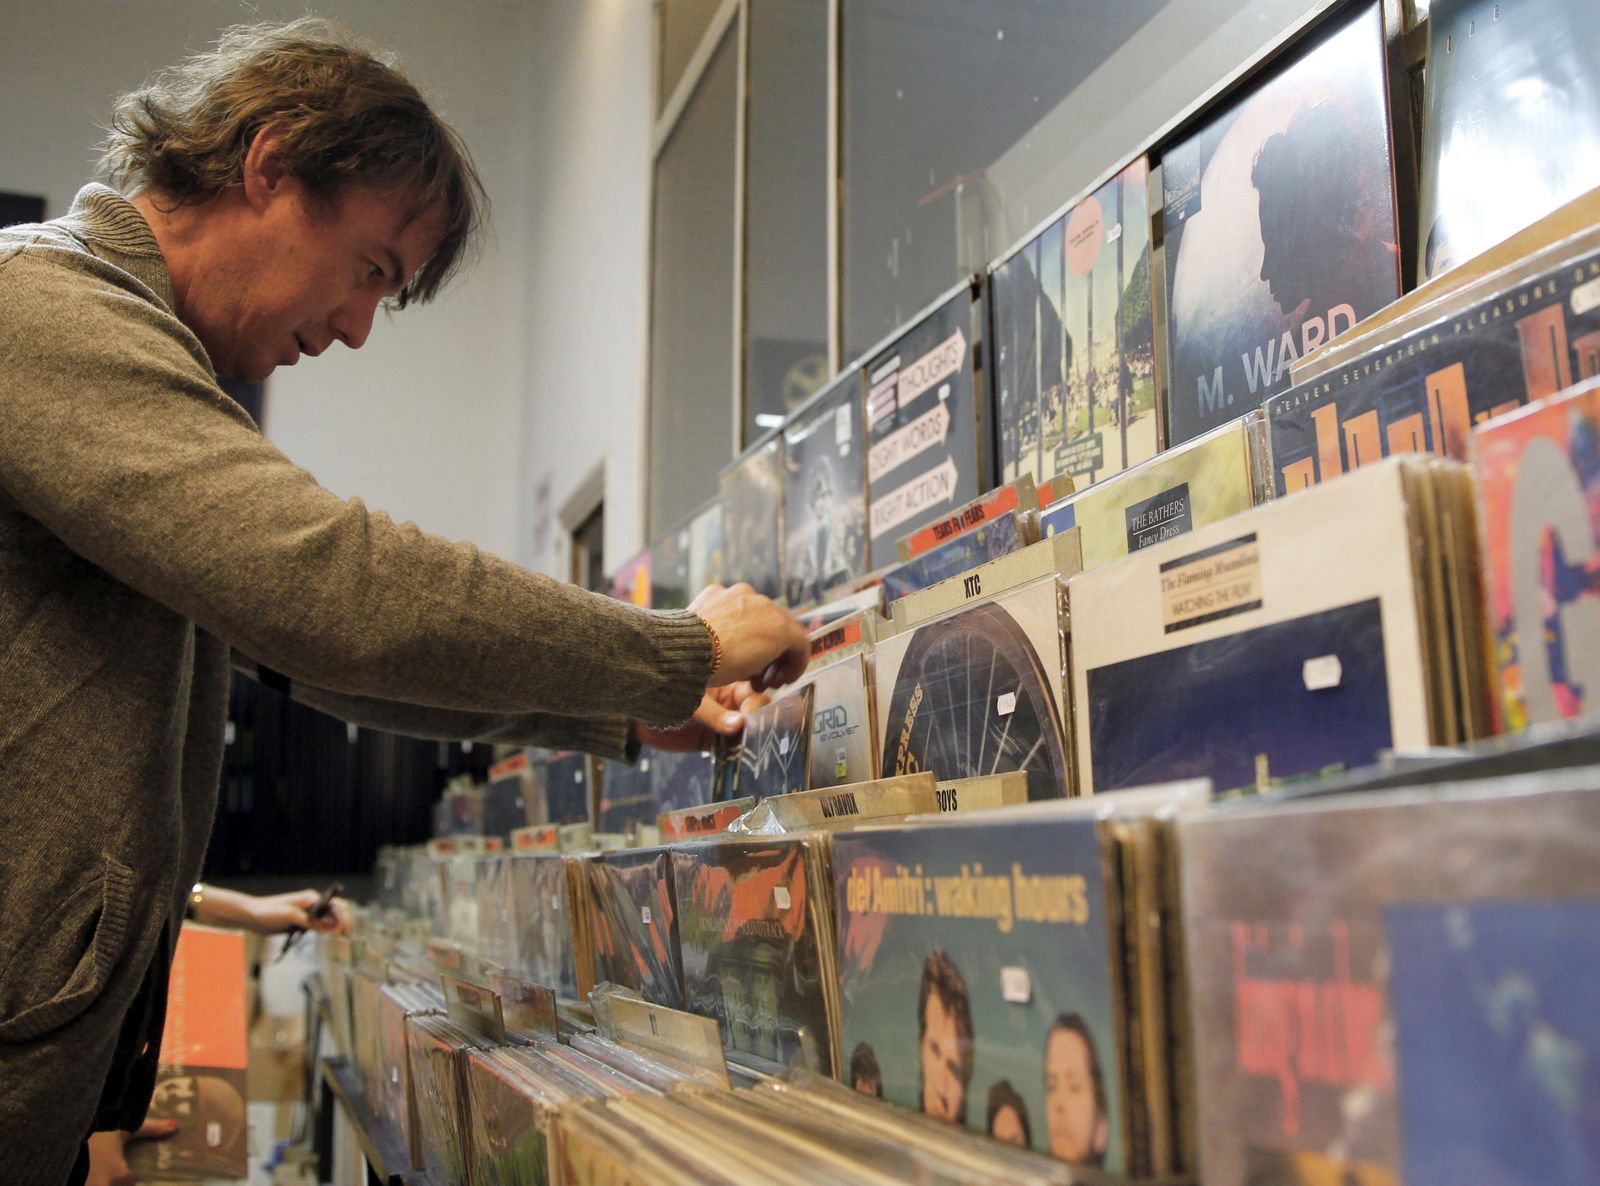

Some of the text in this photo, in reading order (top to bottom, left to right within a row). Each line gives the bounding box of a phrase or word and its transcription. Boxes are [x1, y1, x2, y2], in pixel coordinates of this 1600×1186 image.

[1197, 303, 1357, 418] M. WARD
[1276, 383, 1330, 415] HEAVEN
[1343, 334, 1440, 385] SEVENTEEN
[1454, 279, 1558, 334] PLEASURE
[1132, 498, 1184, 531] THE BATHERS
[1160, 524, 1180, 541] Dress
[964, 574, 981, 599] XTC
[820, 792, 859, 818] ULTRAVOX
